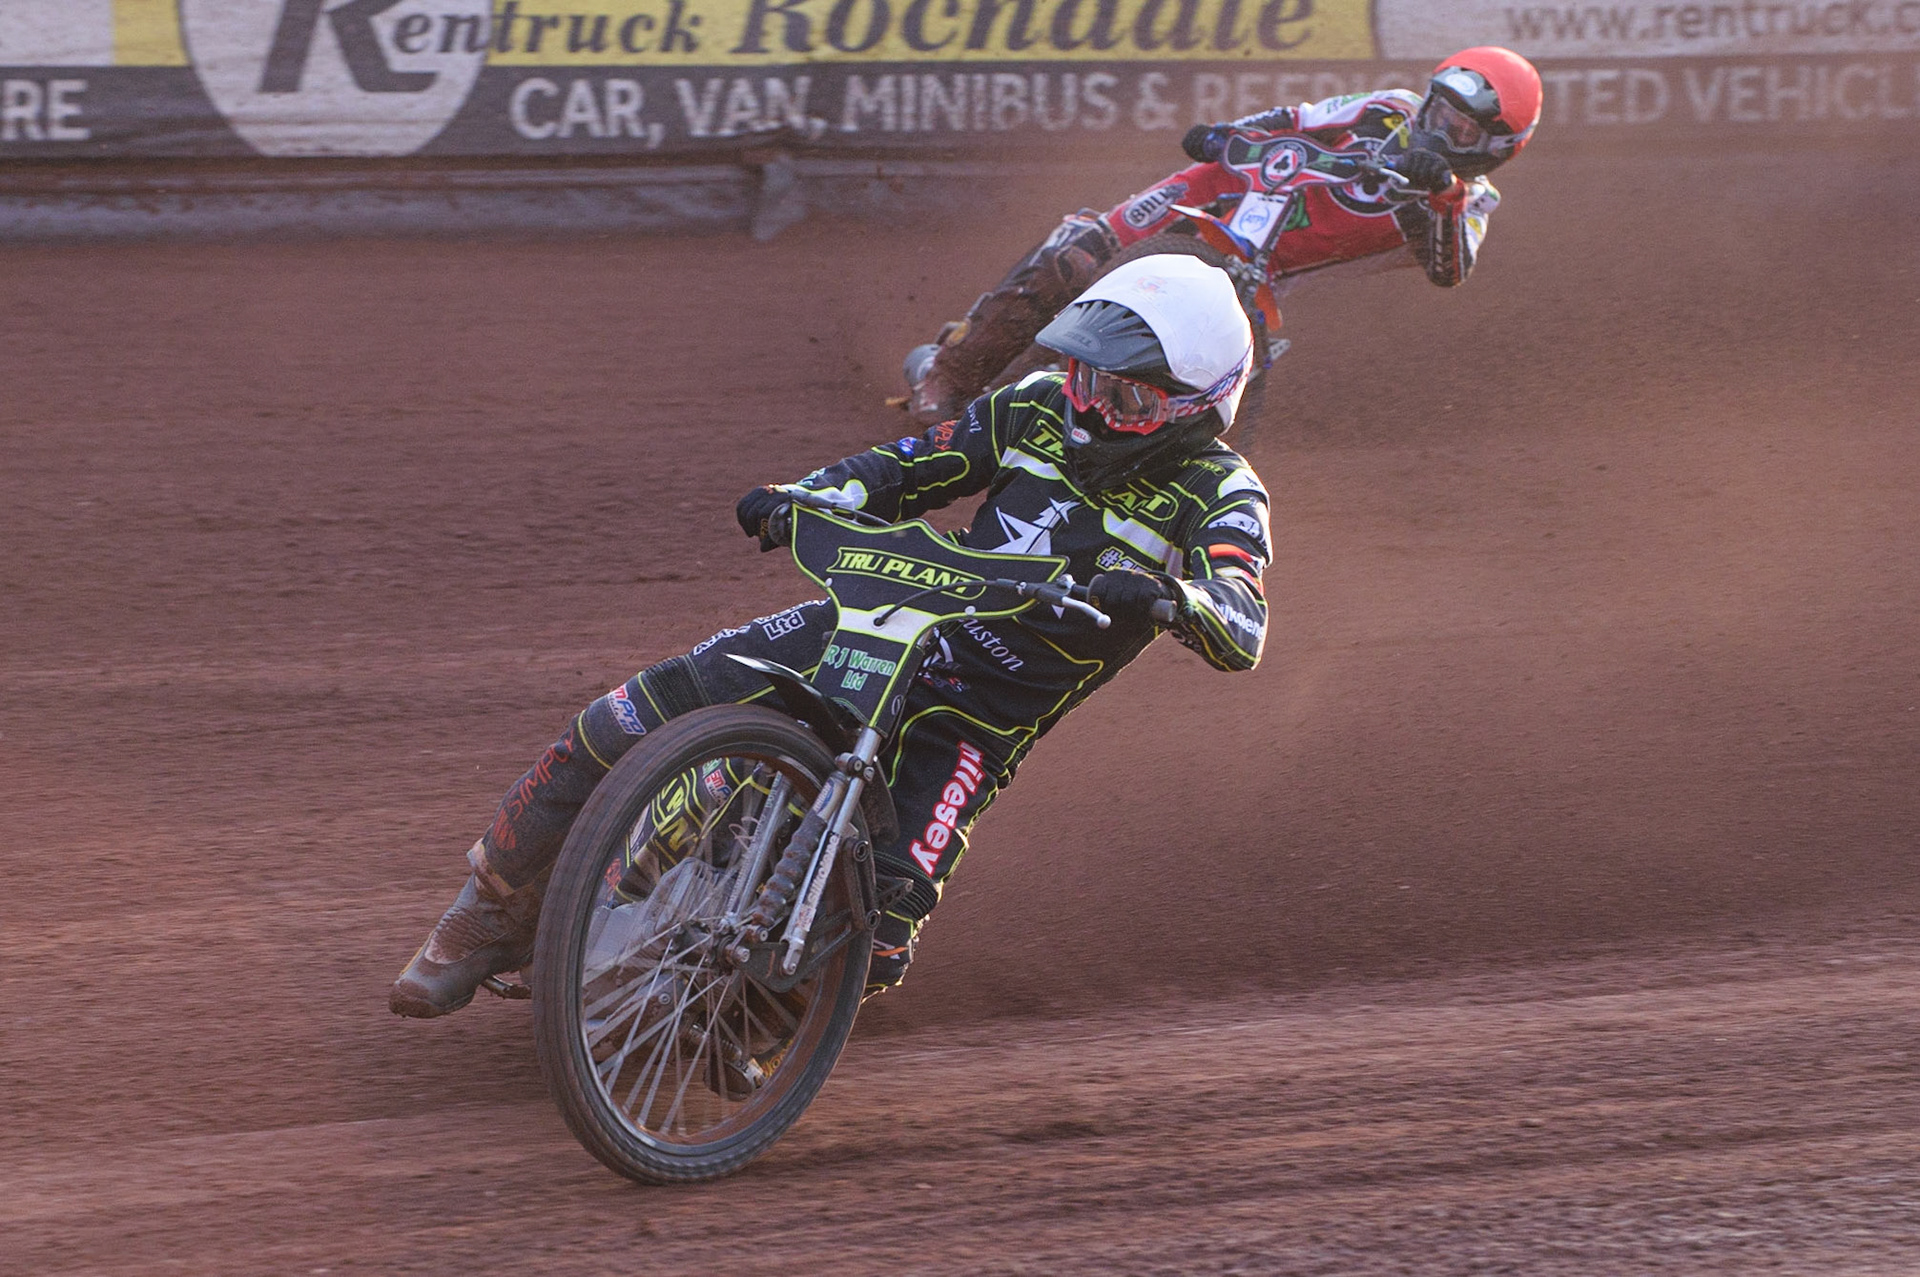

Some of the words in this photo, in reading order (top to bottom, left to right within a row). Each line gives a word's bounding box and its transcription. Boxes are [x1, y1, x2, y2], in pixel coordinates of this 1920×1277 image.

[509, 76, 666, 149] CAR,
[674, 75, 828, 140] VAN,
[841, 72, 1118, 132] MINIBUS
[1134, 72, 1178, 130] &
[1683, 63, 1920, 123] VEHICL
[1071, 428, 1088, 441] BELL
[839, 552, 884, 572] TRU
[881, 558, 973, 594] PLANT
[764, 611, 805, 640] Ltd
[957, 617, 1025, 673] uston
[848, 649, 897, 677] Warren
[840, 669, 869, 691] Ltd
